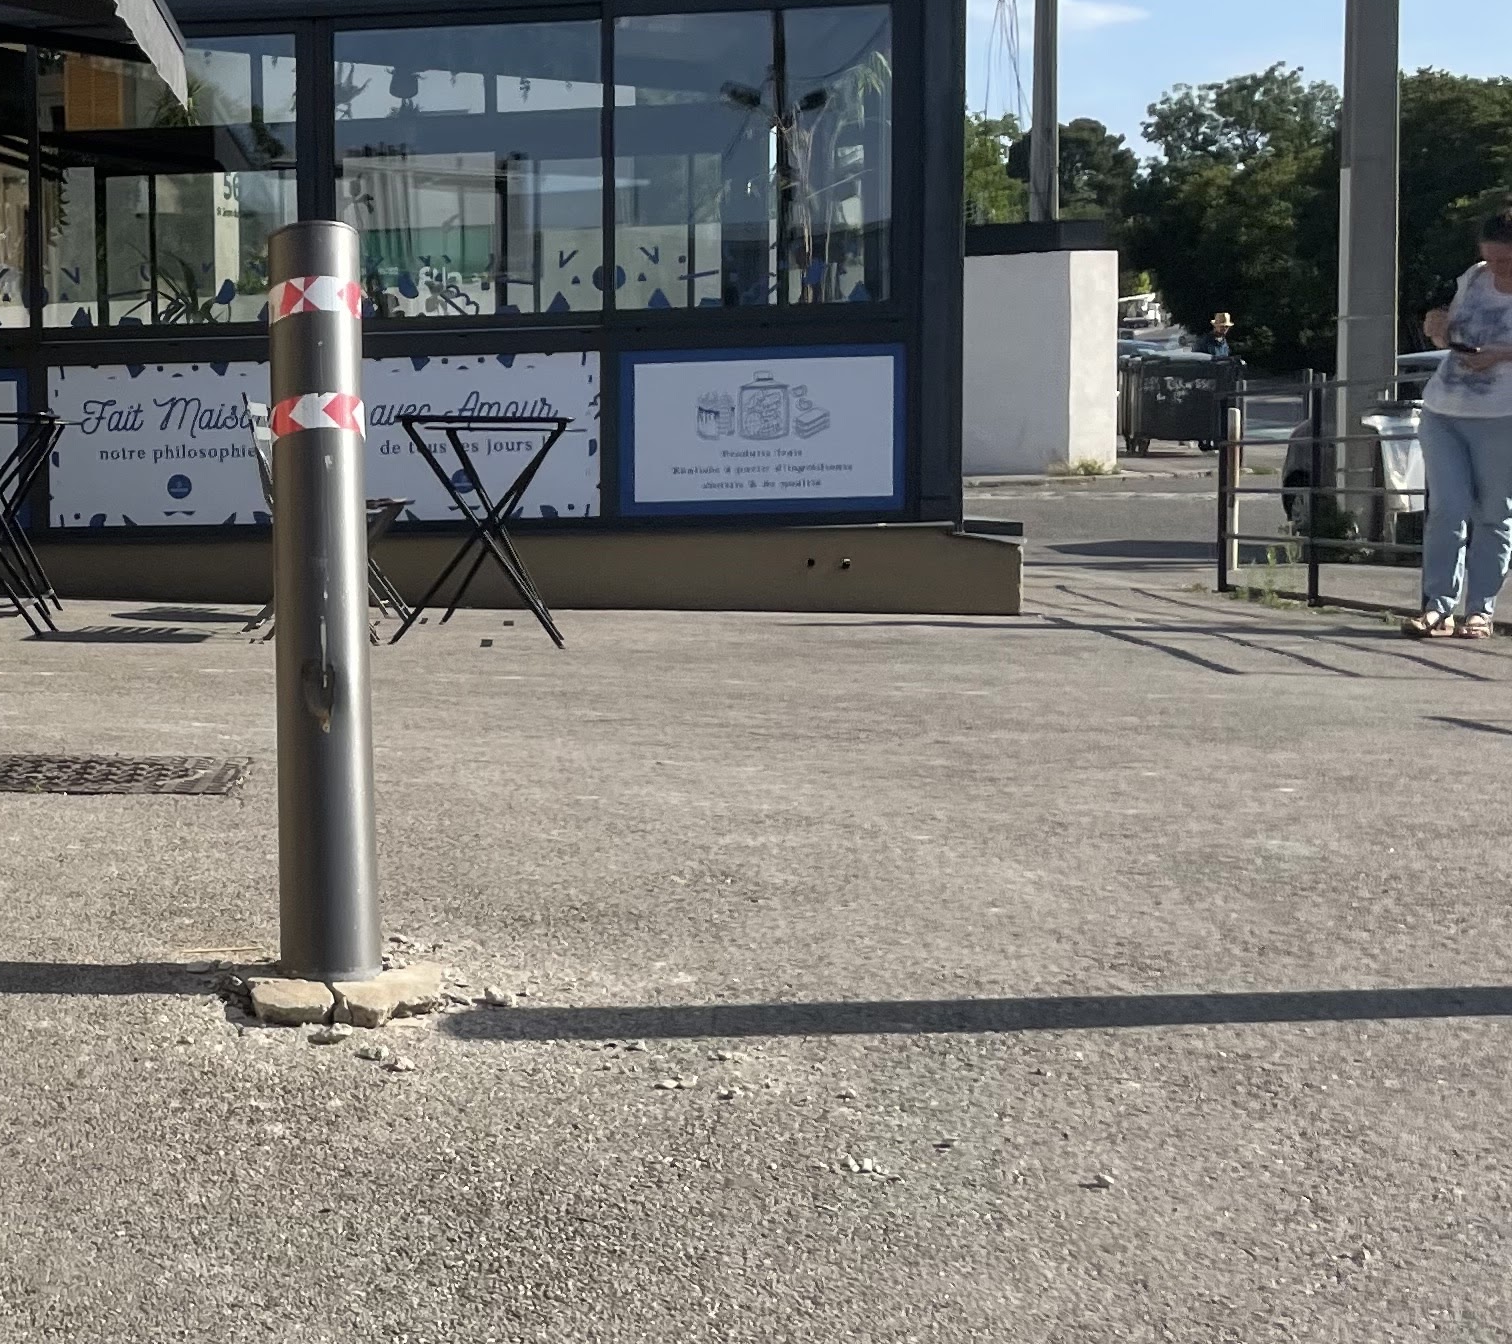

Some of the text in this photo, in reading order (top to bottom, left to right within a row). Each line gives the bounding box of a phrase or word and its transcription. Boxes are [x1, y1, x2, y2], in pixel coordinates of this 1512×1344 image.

[81, 399, 145, 435] Fait
[153, 396, 267, 438] Maiso
[99, 447, 146, 460] notre
[152, 443, 258, 464] philosophie
[380, 440, 401, 455] de
[487, 438, 533, 456] jours
